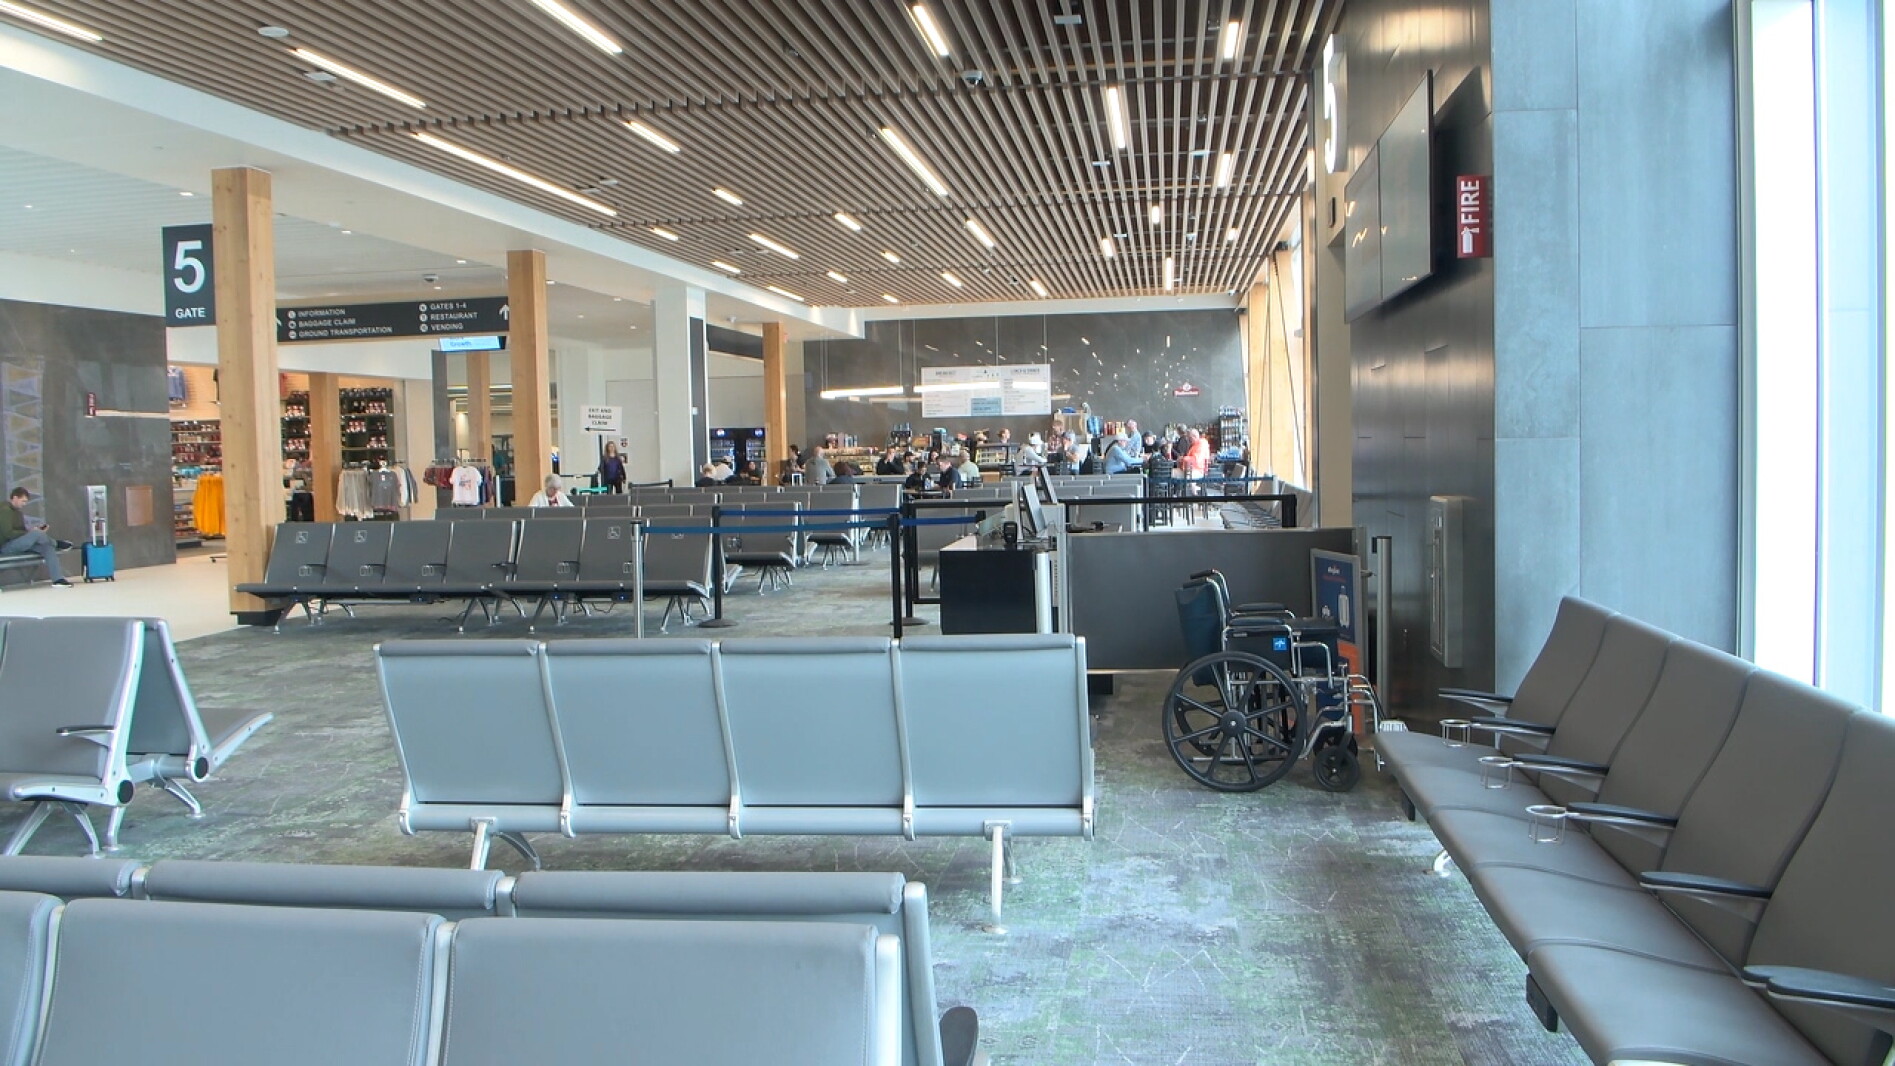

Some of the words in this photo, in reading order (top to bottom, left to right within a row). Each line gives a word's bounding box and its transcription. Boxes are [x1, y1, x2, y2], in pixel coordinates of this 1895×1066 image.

[1323, 33, 1343, 173] 5
[1461, 180, 1480, 224] FIRE
[174, 240, 205, 293] 5
[430, 302, 454, 310] GATES
[175, 307, 206, 318] GATE
[298, 308, 345, 318] INFORMATION
[430, 312, 478, 321] RESTAURANT
[298, 319, 332, 328] BAGGAGE
[334, 317, 356, 326] CLAIM
[430, 323, 464, 331] VENDING
[298, 329, 329, 337] GROUND
[330, 327, 393, 336] TRANSPORTATION
